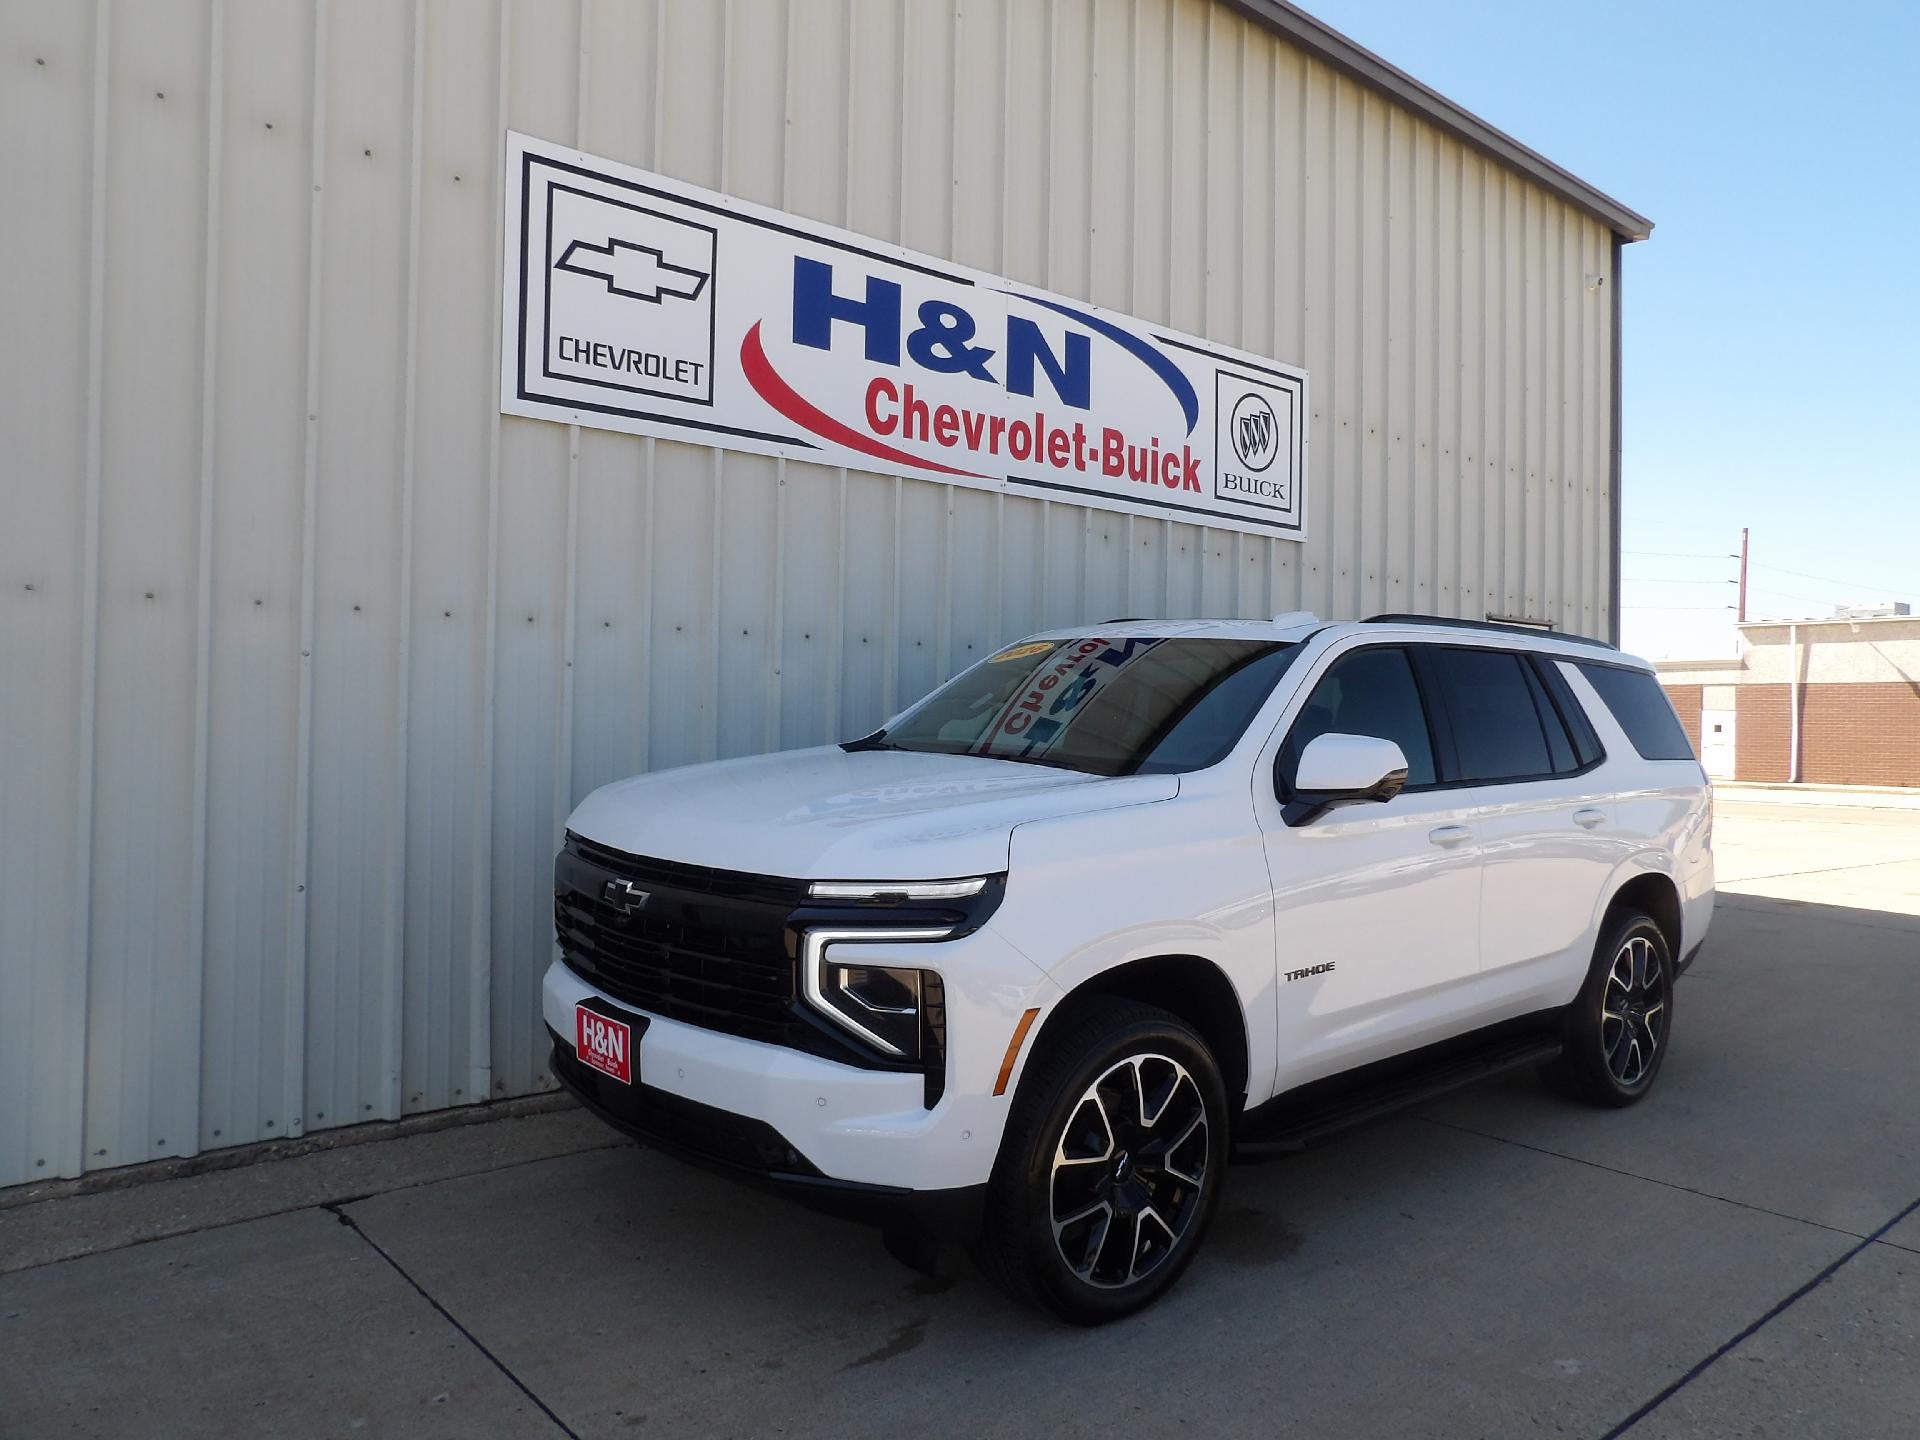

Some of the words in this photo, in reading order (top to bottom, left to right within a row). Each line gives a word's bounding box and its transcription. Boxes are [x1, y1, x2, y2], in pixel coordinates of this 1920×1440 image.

[792, 255, 1091, 411] H&N
[558, 335, 705, 386] CHEVROLET
[865, 377, 1202, 493] Chevrolet-Buick
[1223, 472, 1286, 501] BUICK
[1284, 961, 1336, 982] TAHOE
[583, 1014, 623, 1064] H&N
